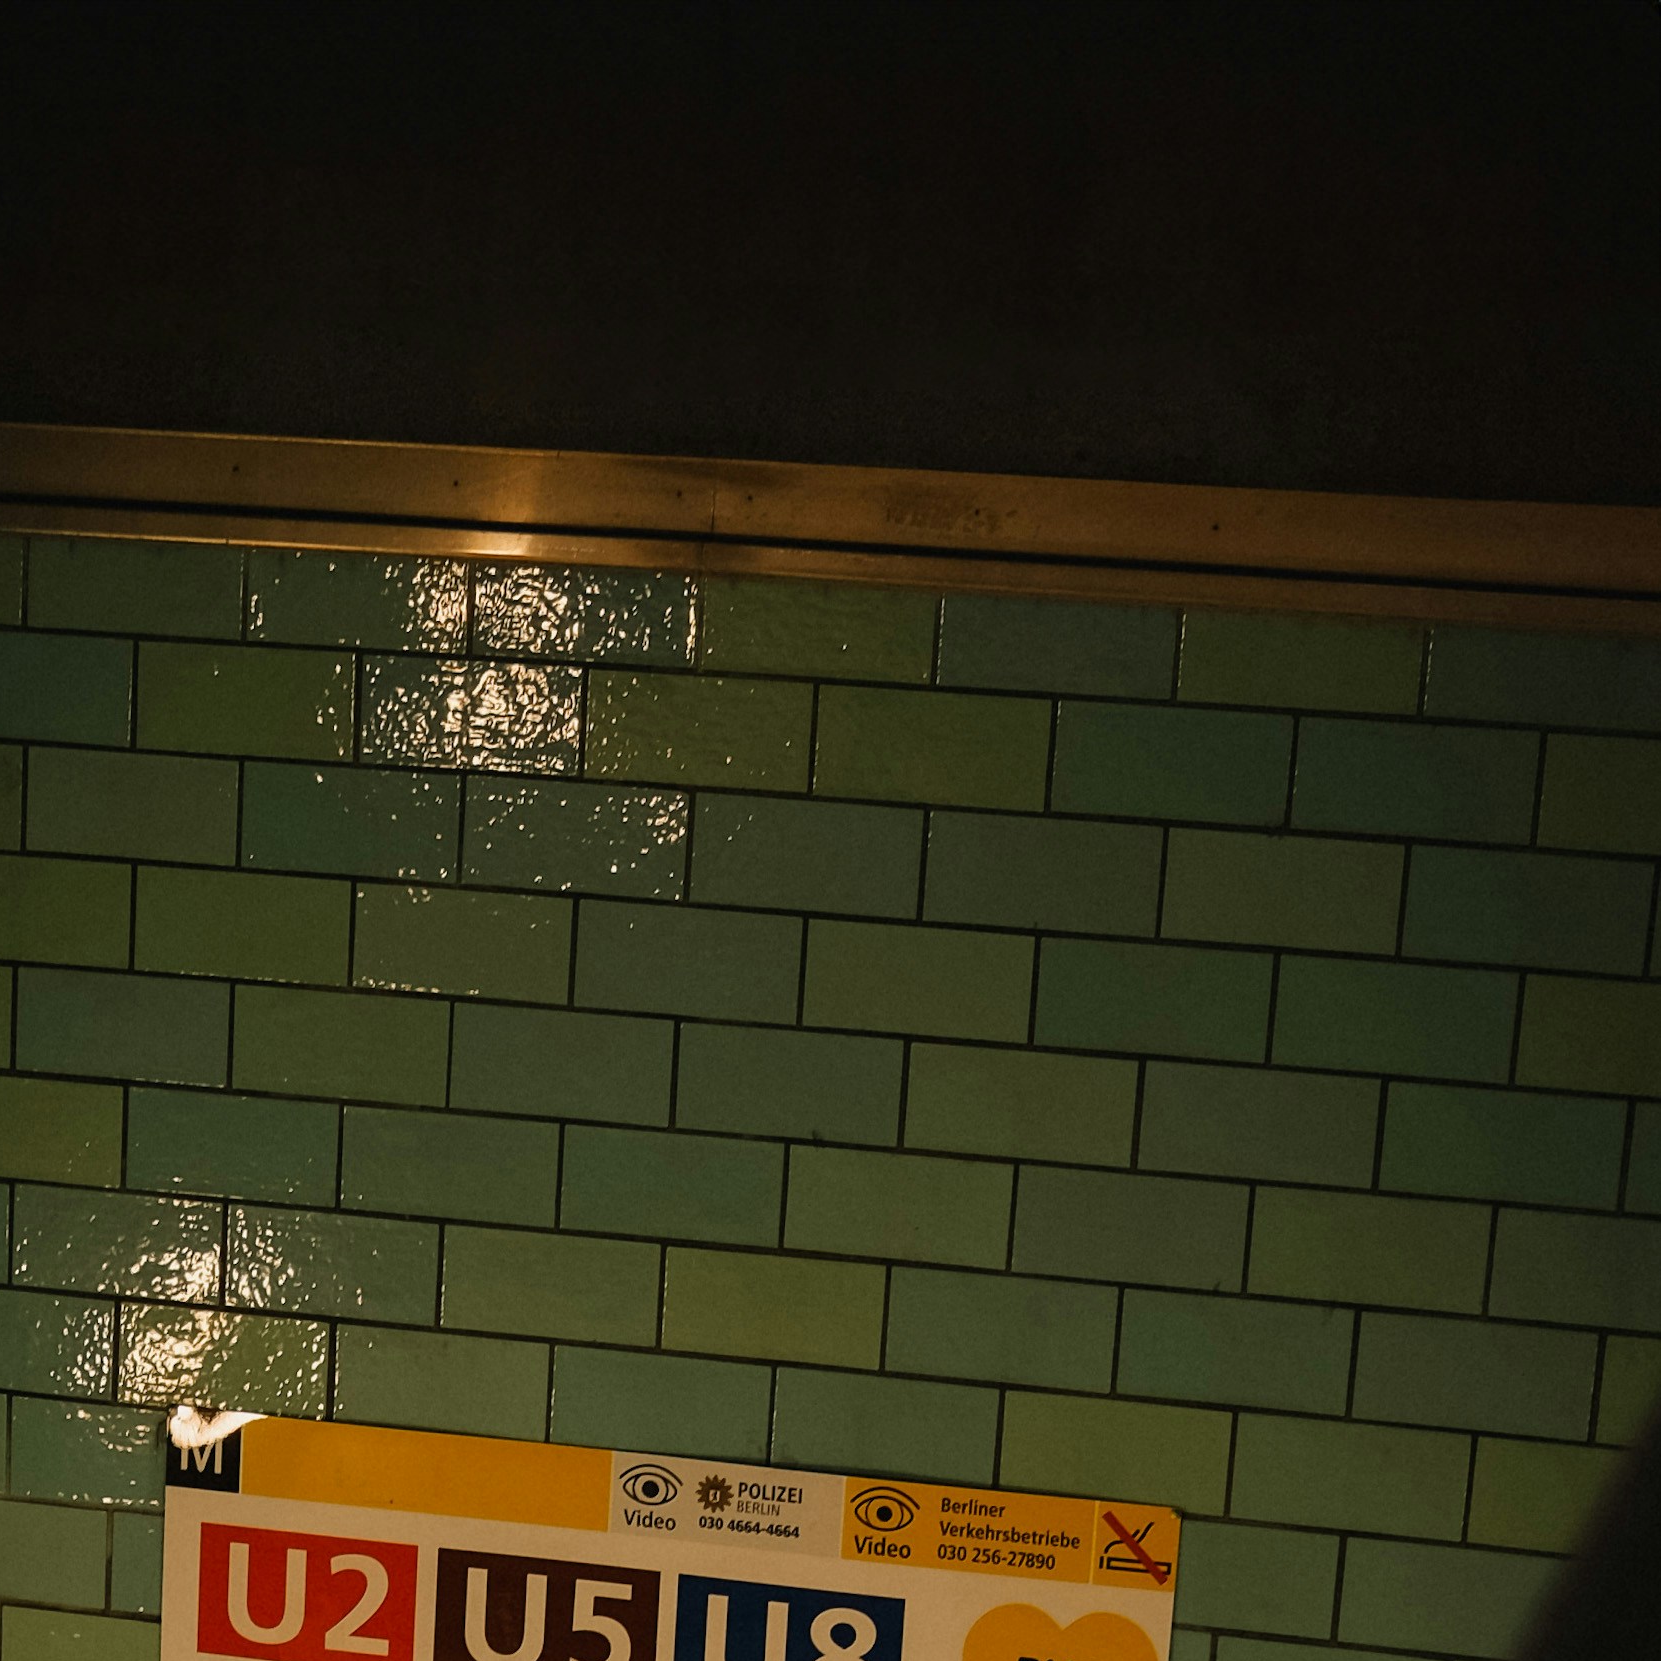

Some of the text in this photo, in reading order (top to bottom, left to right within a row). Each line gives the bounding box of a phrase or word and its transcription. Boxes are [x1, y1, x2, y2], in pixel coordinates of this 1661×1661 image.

[738, 1482, 803, 1504] POLIZEI
[736, 1500, 781, 1516] BERLIN
[941, 1498, 1006, 1518] Berliner
[624, 1509, 677, 1531] Video
[699, 1516, 800, 1538] 030 4664-4664
[939, 1520, 1081, 1549] Verkehrsbetriebe
[854, 1535, 911, 1559] Video
[937, 1545, 1056, 1570] 030 256-27890
[227, 1542, 390, 1657] U2
